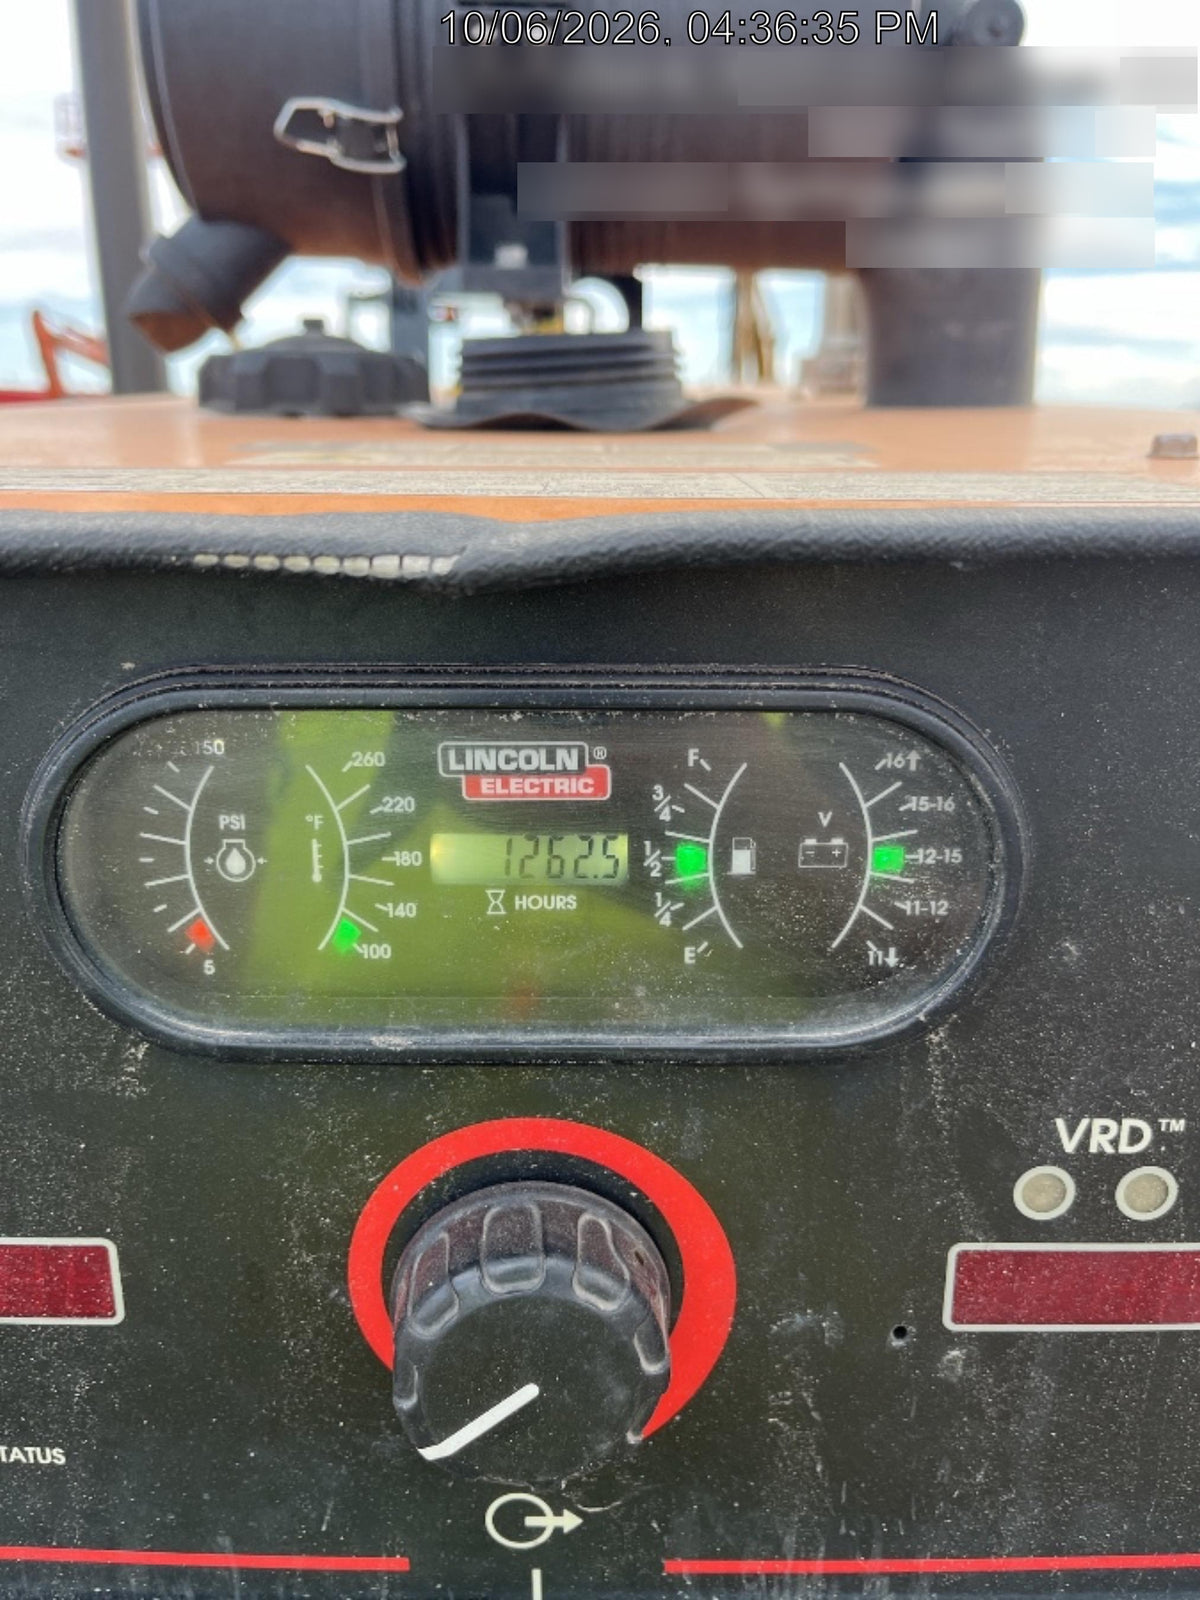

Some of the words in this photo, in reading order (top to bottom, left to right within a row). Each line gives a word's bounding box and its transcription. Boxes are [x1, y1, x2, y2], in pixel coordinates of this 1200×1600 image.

[352, 751, 386, 767] 260
[448, 747, 579, 771] LINCOLN
[688, 749, 699, 767] F
[480, 777, 595, 794] ELECTRIC
[382, 796, 415, 812] 220
[911, 796, 955, 812] 15-16
[219, 815, 246, 830] PSI
[818, 812, 832, 827] V
[394, 851, 422, 866] 180
[505, 834, 619, 879] 1262.5
[919, 850, 962, 865] 12-15
[387, 902, 417, 918] 140
[514, 895, 577, 911] HOURS
[907, 902, 949, 916] 11-12
[362, 944, 391, 960] 100
[684, 947, 696, 964] E
[1055, 1117, 1153, 1154] VRD
